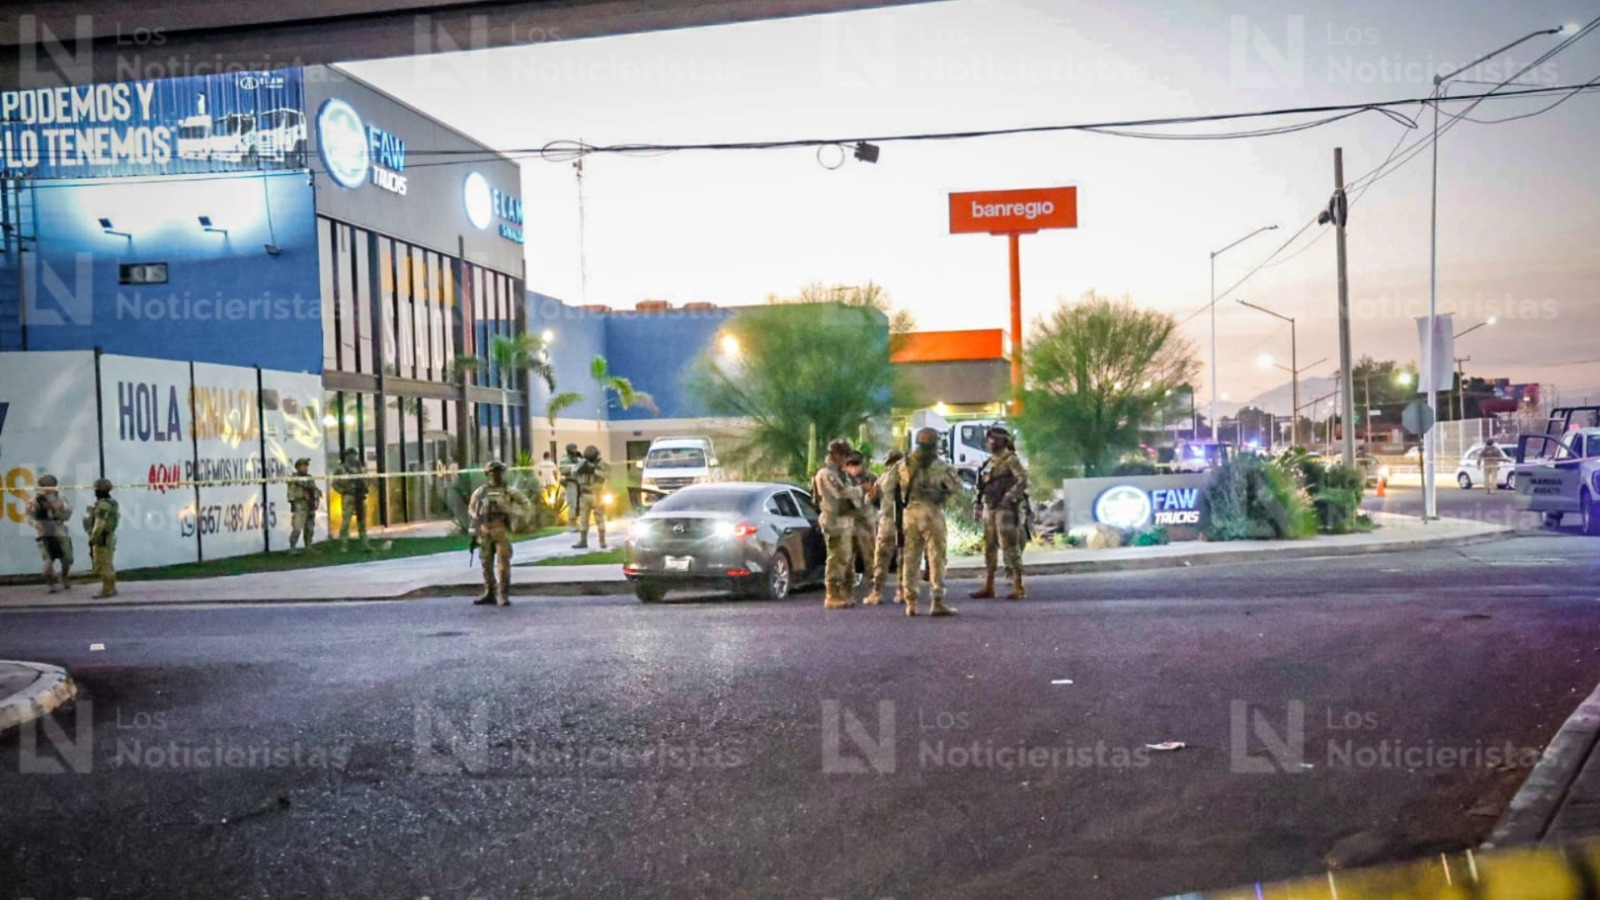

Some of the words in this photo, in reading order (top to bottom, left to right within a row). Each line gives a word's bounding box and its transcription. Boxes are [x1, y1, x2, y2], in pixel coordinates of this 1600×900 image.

[1, 83, 131, 125] PODEMOS
[135, 82, 155, 121] Y
[4, 131, 40, 168] LO
[43, 126, 171, 167] TENEMOS
[369, 126, 405, 172] FAW
[972, 200, 1054, 219] banregio
[117, 381, 182, 442] HOLA
[246, 502, 277, 530] 205
[1151, 488, 1198, 510] FAW
[1154, 511, 1200, 525] TRUCKS
